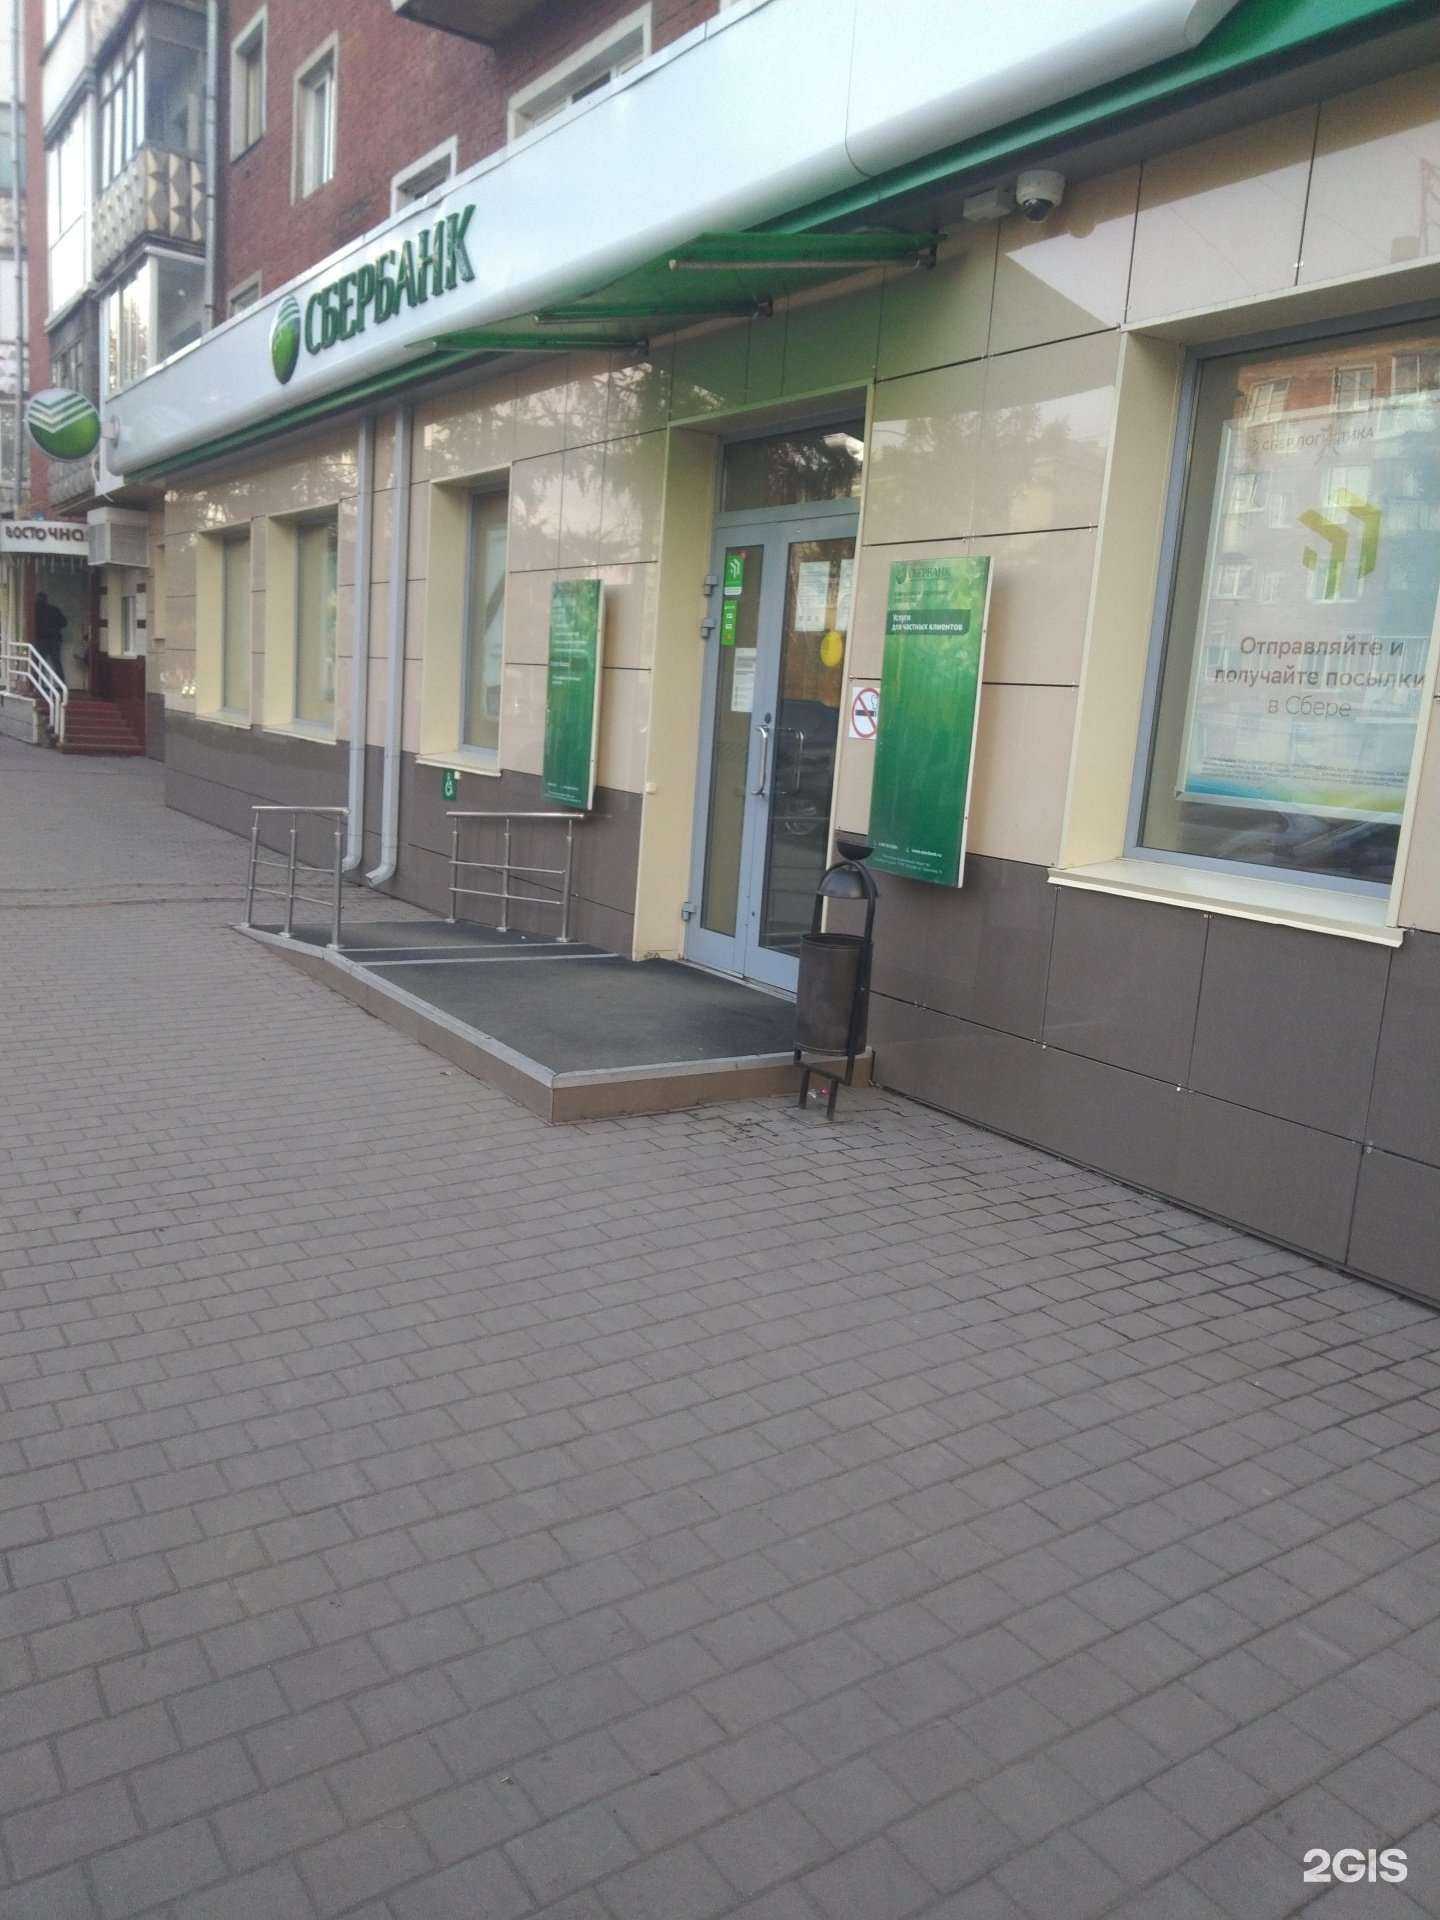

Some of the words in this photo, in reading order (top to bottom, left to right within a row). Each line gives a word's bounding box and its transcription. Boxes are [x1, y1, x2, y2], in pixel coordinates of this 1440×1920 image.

[304, 204, 476, 356] СБЕРБАНК
[929, 623, 963, 631] клиентов
[1240, 634, 1383, 659] Отправляйте
[1390, 641, 1405, 656] и
[1214, 665, 1319, 688] получайте
[1325, 672, 1425, 688] посылки
[1267, 700, 1279, 714] в
[1285, 695, 1351, 719] Сбере
